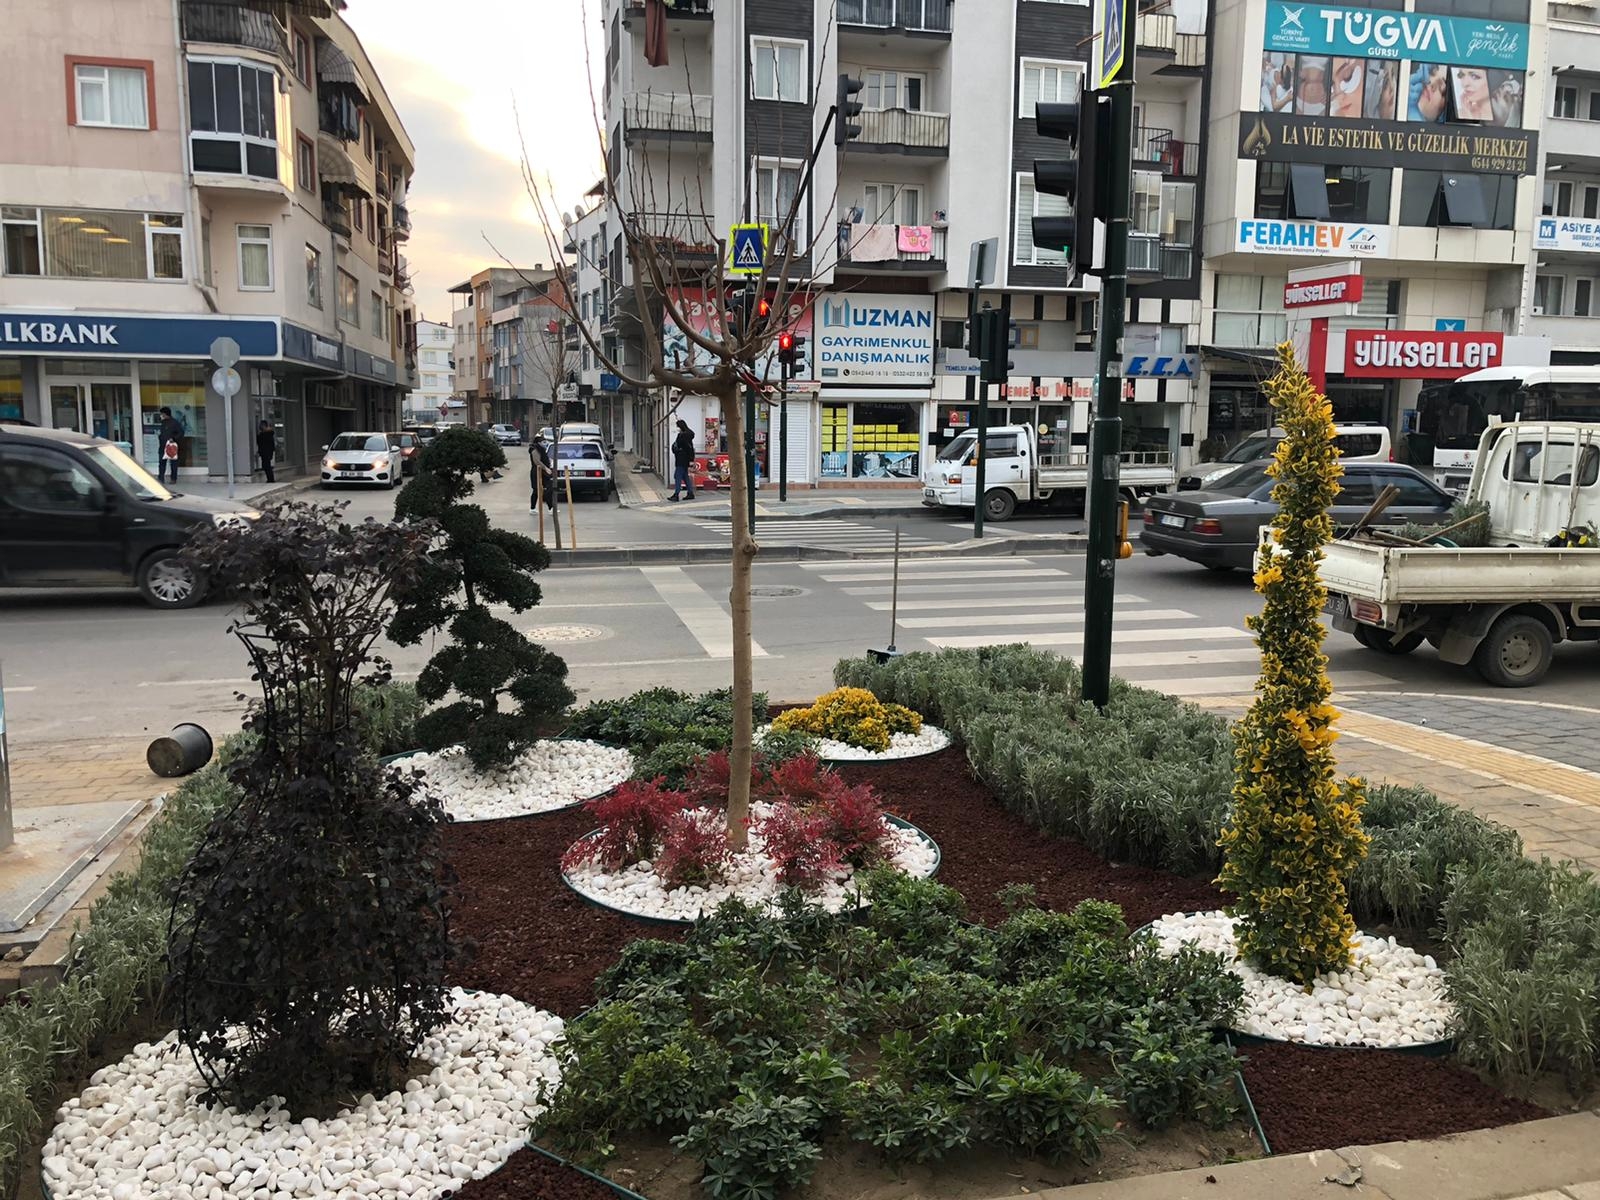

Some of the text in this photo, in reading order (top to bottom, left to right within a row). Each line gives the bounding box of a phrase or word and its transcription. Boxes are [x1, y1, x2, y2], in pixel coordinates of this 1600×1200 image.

[1320, 9, 1448, 52] TÜGVA
[1282, 121, 1528, 159] LA VİE ESTETİK VE GÜZELLİK MERKEZİ
[1240, 221, 1344, 248] FERAHEV
[853, 308, 931, 327] UZMAN
[0, 321, 119, 344] LKBANK
[822, 351, 930, 364] DANIŞMANLIK
